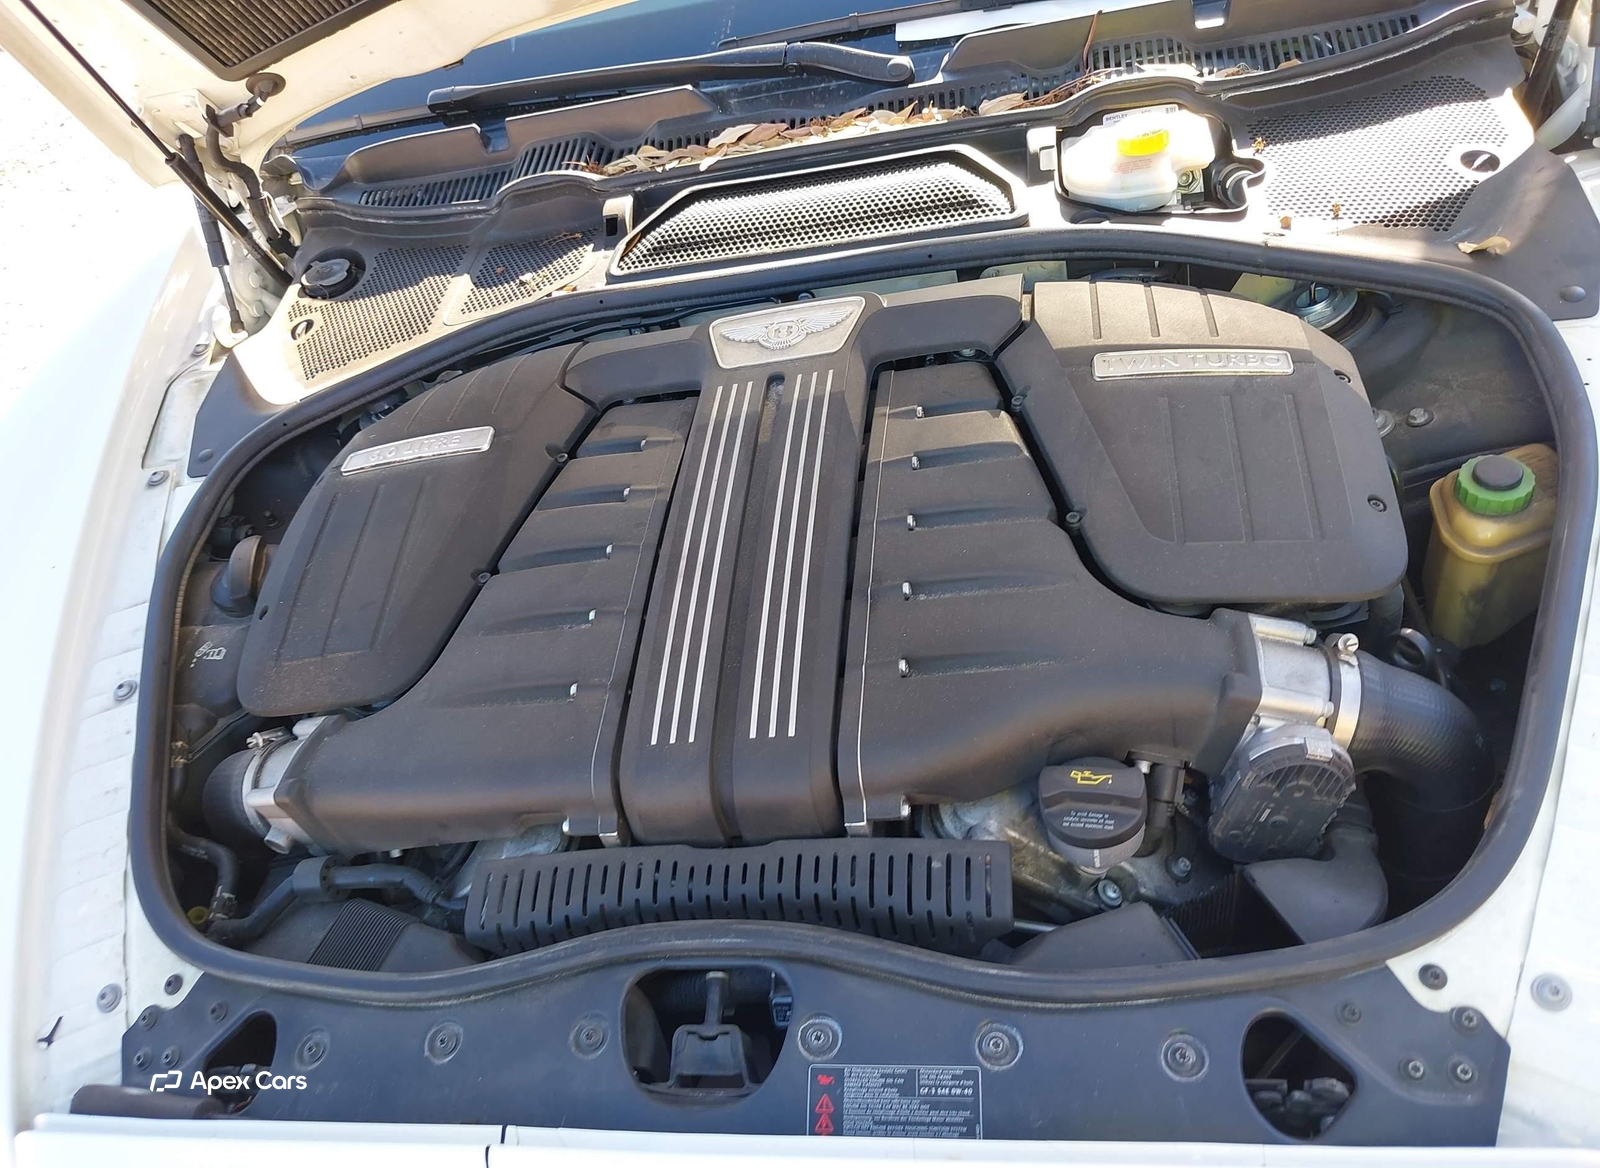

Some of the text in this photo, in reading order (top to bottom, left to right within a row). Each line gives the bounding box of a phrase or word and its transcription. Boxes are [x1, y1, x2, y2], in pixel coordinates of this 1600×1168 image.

[1102, 354, 1284, 371] TWIN TURBO
[404, 436, 462, 455] LITRE
